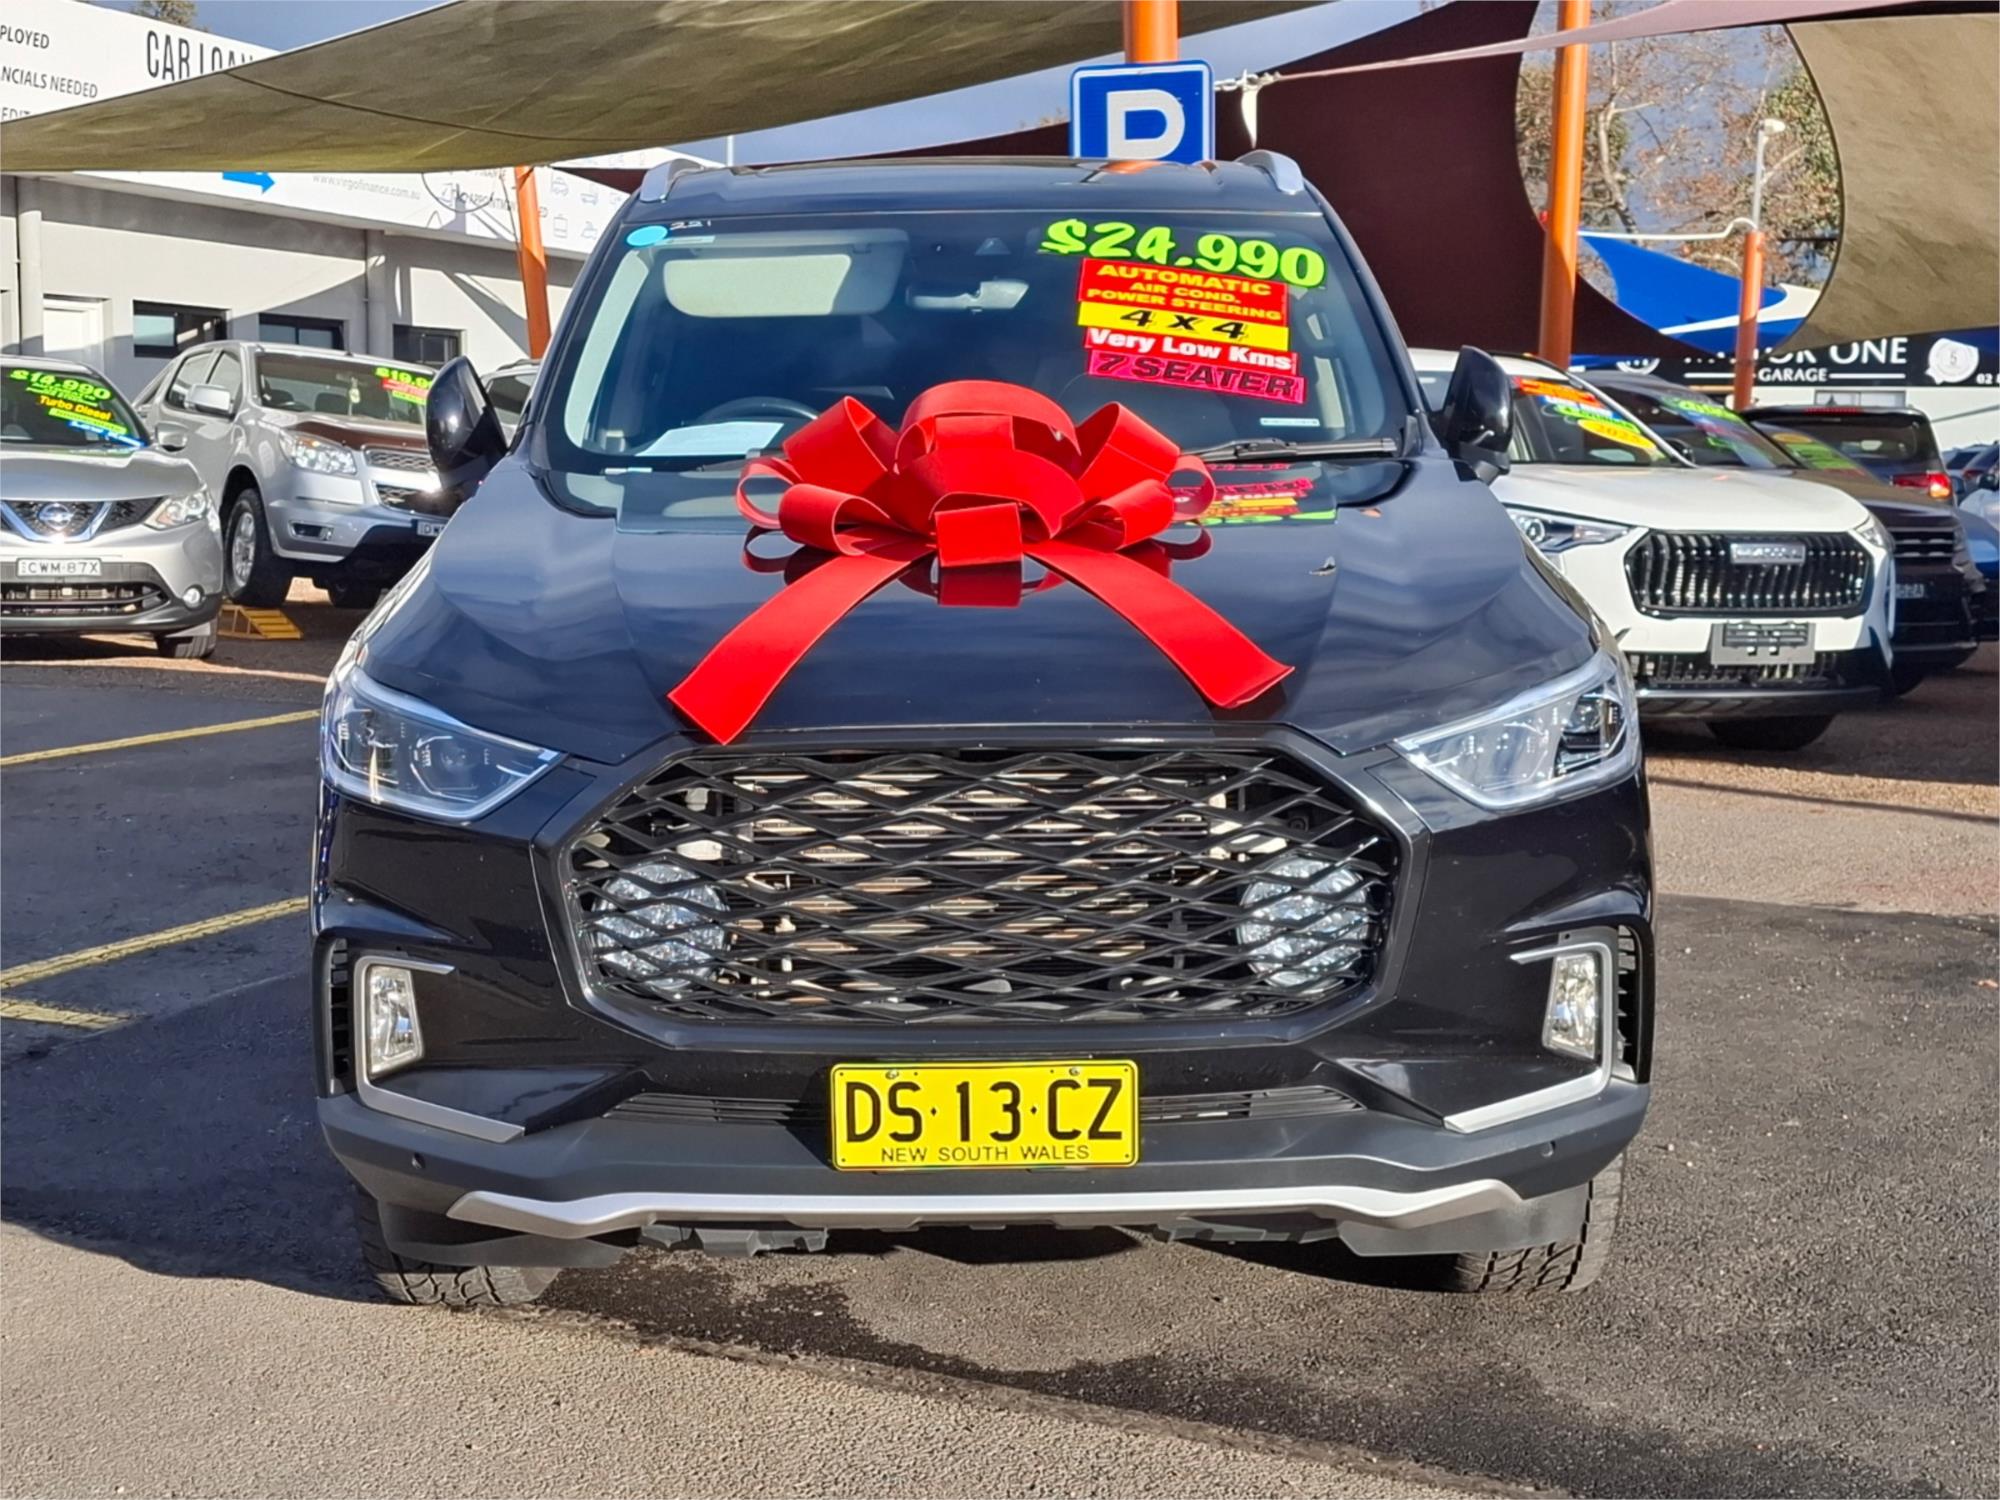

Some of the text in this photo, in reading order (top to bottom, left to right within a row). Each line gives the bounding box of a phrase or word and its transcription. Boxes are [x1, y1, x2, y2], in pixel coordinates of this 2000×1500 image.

[147, 30, 190, 82] CAR
[50, 75, 98, 99] NEEDED
[1097, 264, 1271, 295] AUTOMATIC
[1130, 282, 1241, 304] AIR COND.
[1087, 288, 1281, 320] POWER STEERING
[1120, 309, 1154, 328] 4
[1212, 321, 1247, 340] 4
[1088, 329, 1293, 370] Very Low Kms
[1829, 337, 1908, 364] ONE
[1096, 353, 1297, 398] 7 SEATER
[1758, 367, 1828, 382] GARAGE
[40, 395, 73, 410] Turbo
[75, 405, 112, 421] Diesel
[881, 1145, 1090, 1162] NEW SOUTH WALES
